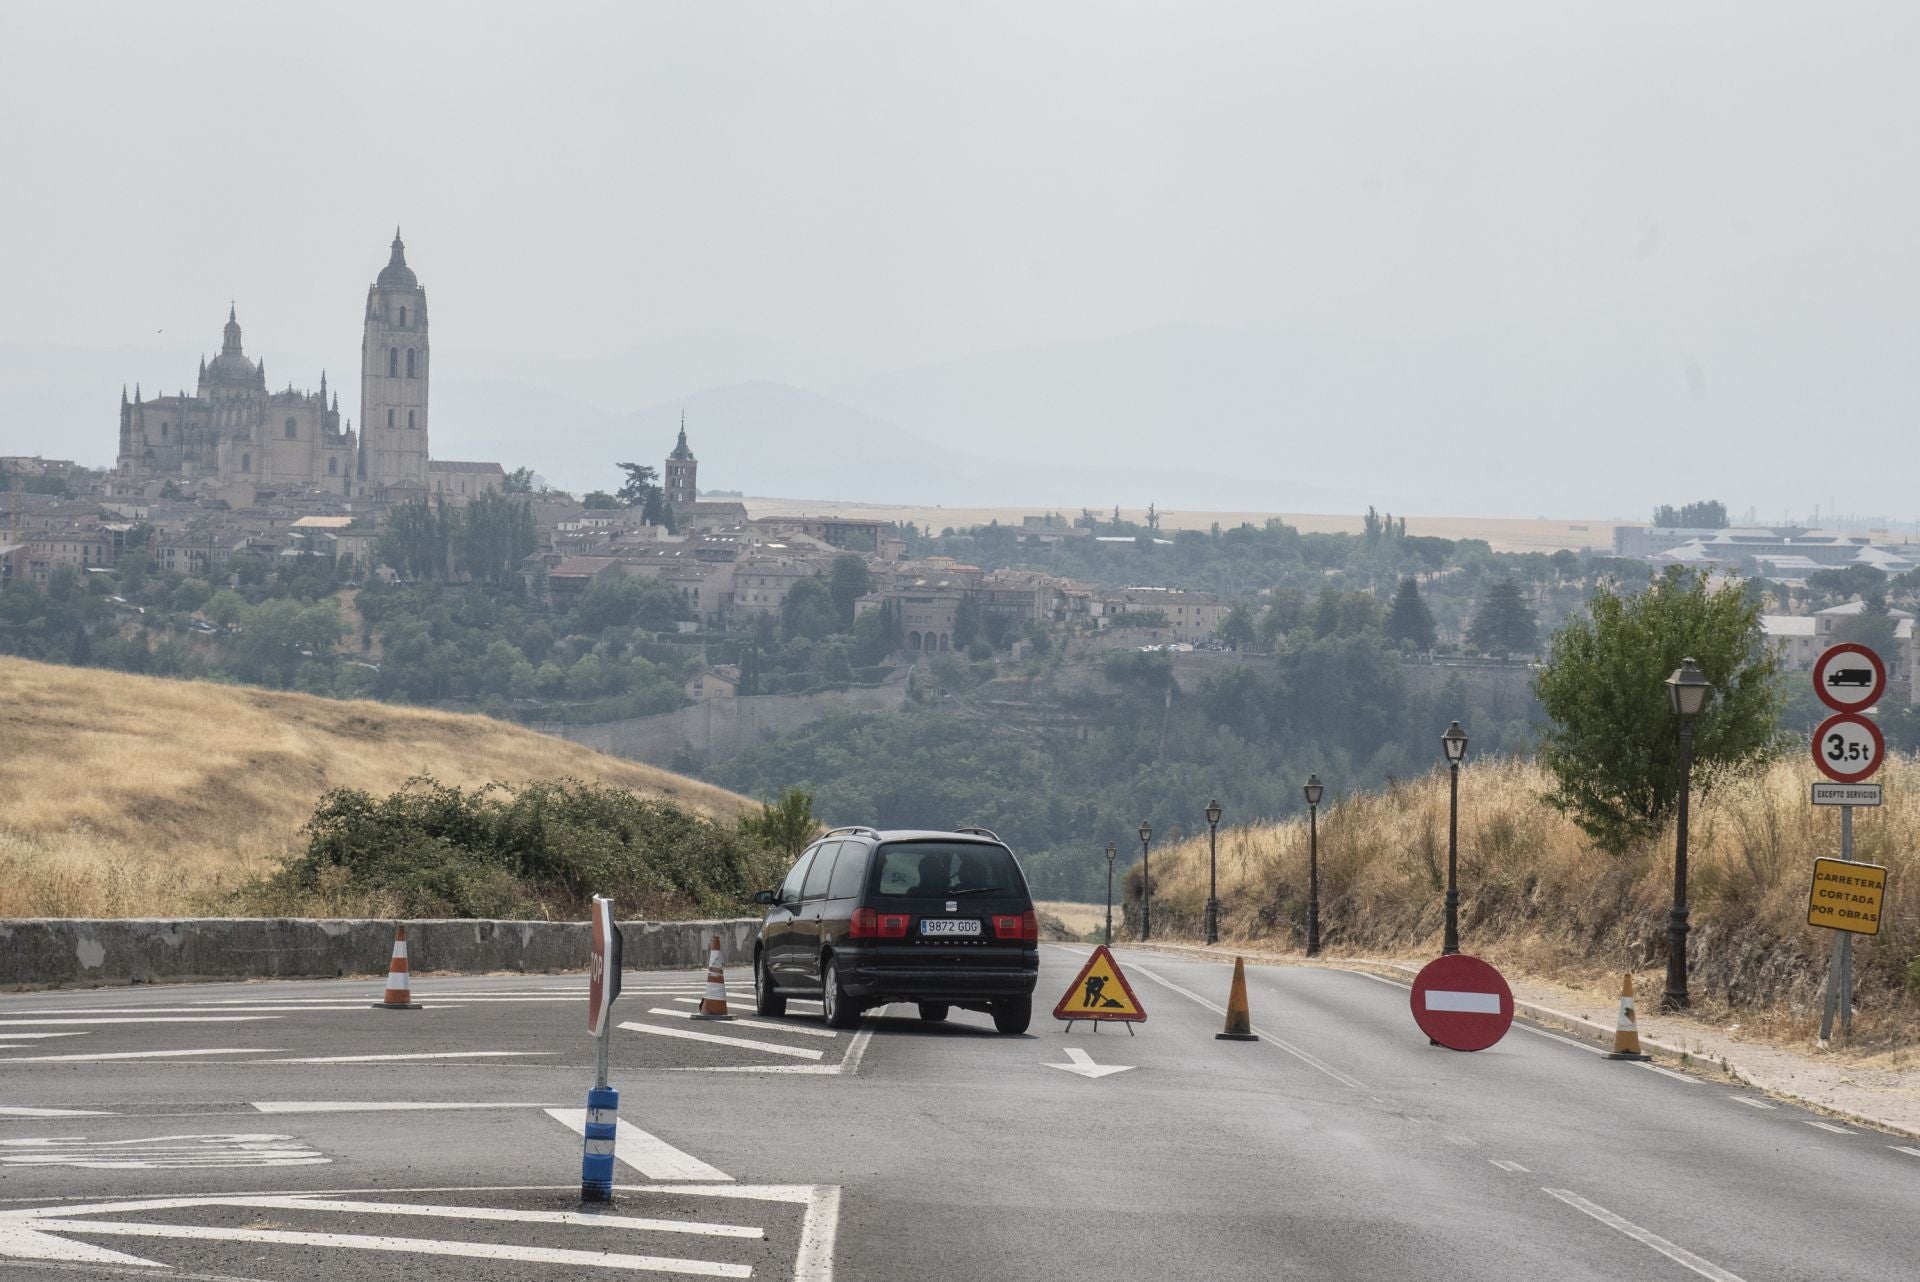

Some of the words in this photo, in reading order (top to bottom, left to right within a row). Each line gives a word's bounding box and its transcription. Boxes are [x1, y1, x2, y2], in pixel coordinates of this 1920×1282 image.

[1817, 790, 1844, 799] EXCEPTO
[1846, 790, 1877, 799] SERVICIOS
[1816, 872, 1882, 889] CARRETERA
[1819, 889, 1874, 905] CORTADA
[1812, 904, 1834, 915] POR
[1838, 909, 1877, 922] OBRAS
[928, 921, 955, 932] 9872
[958, 921, 978, 932] GDG
[591, 951, 603, 984] TOP
